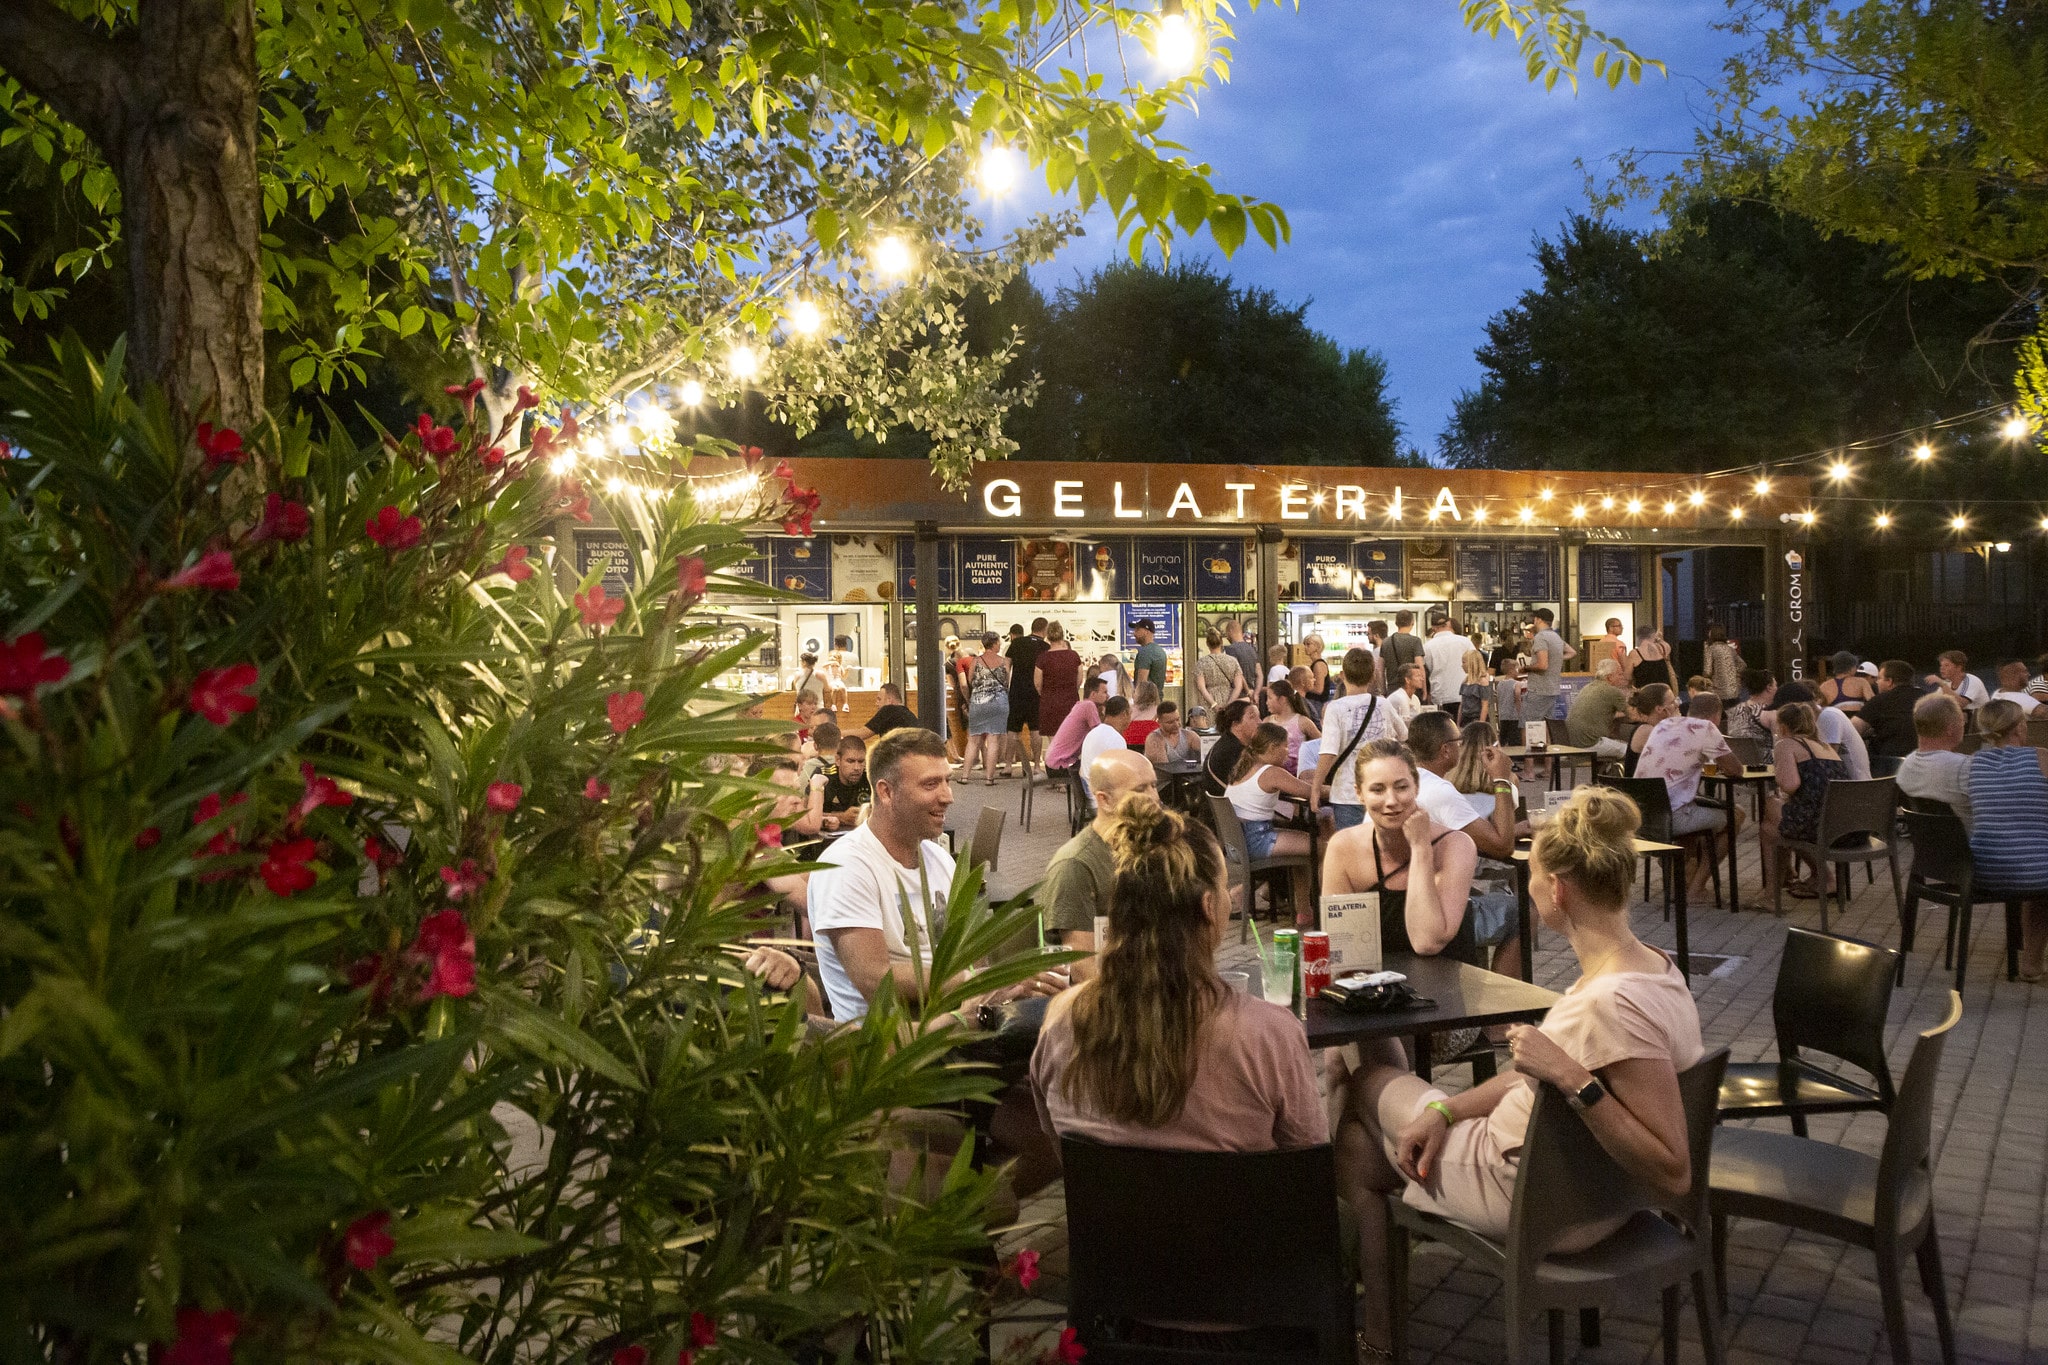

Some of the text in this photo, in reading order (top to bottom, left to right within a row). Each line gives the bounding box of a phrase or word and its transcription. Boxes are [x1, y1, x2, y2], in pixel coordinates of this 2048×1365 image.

[982, 478, 1463, 521] GELATERIA
[602, 542, 629, 550] CONO
[976, 554, 997, 562] PURE
[1142, 553, 1181, 564] human
[1315, 555, 1337, 563] PURO
[971, 569, 1002, 577] ITALIAN
[971, 577, 1002, 585] GELATO
[1143, 574, 1179, 585] GROM
[1790, 573, 1803, 622] GROM
[1328, 903, 1367, 912] GELATERIA
